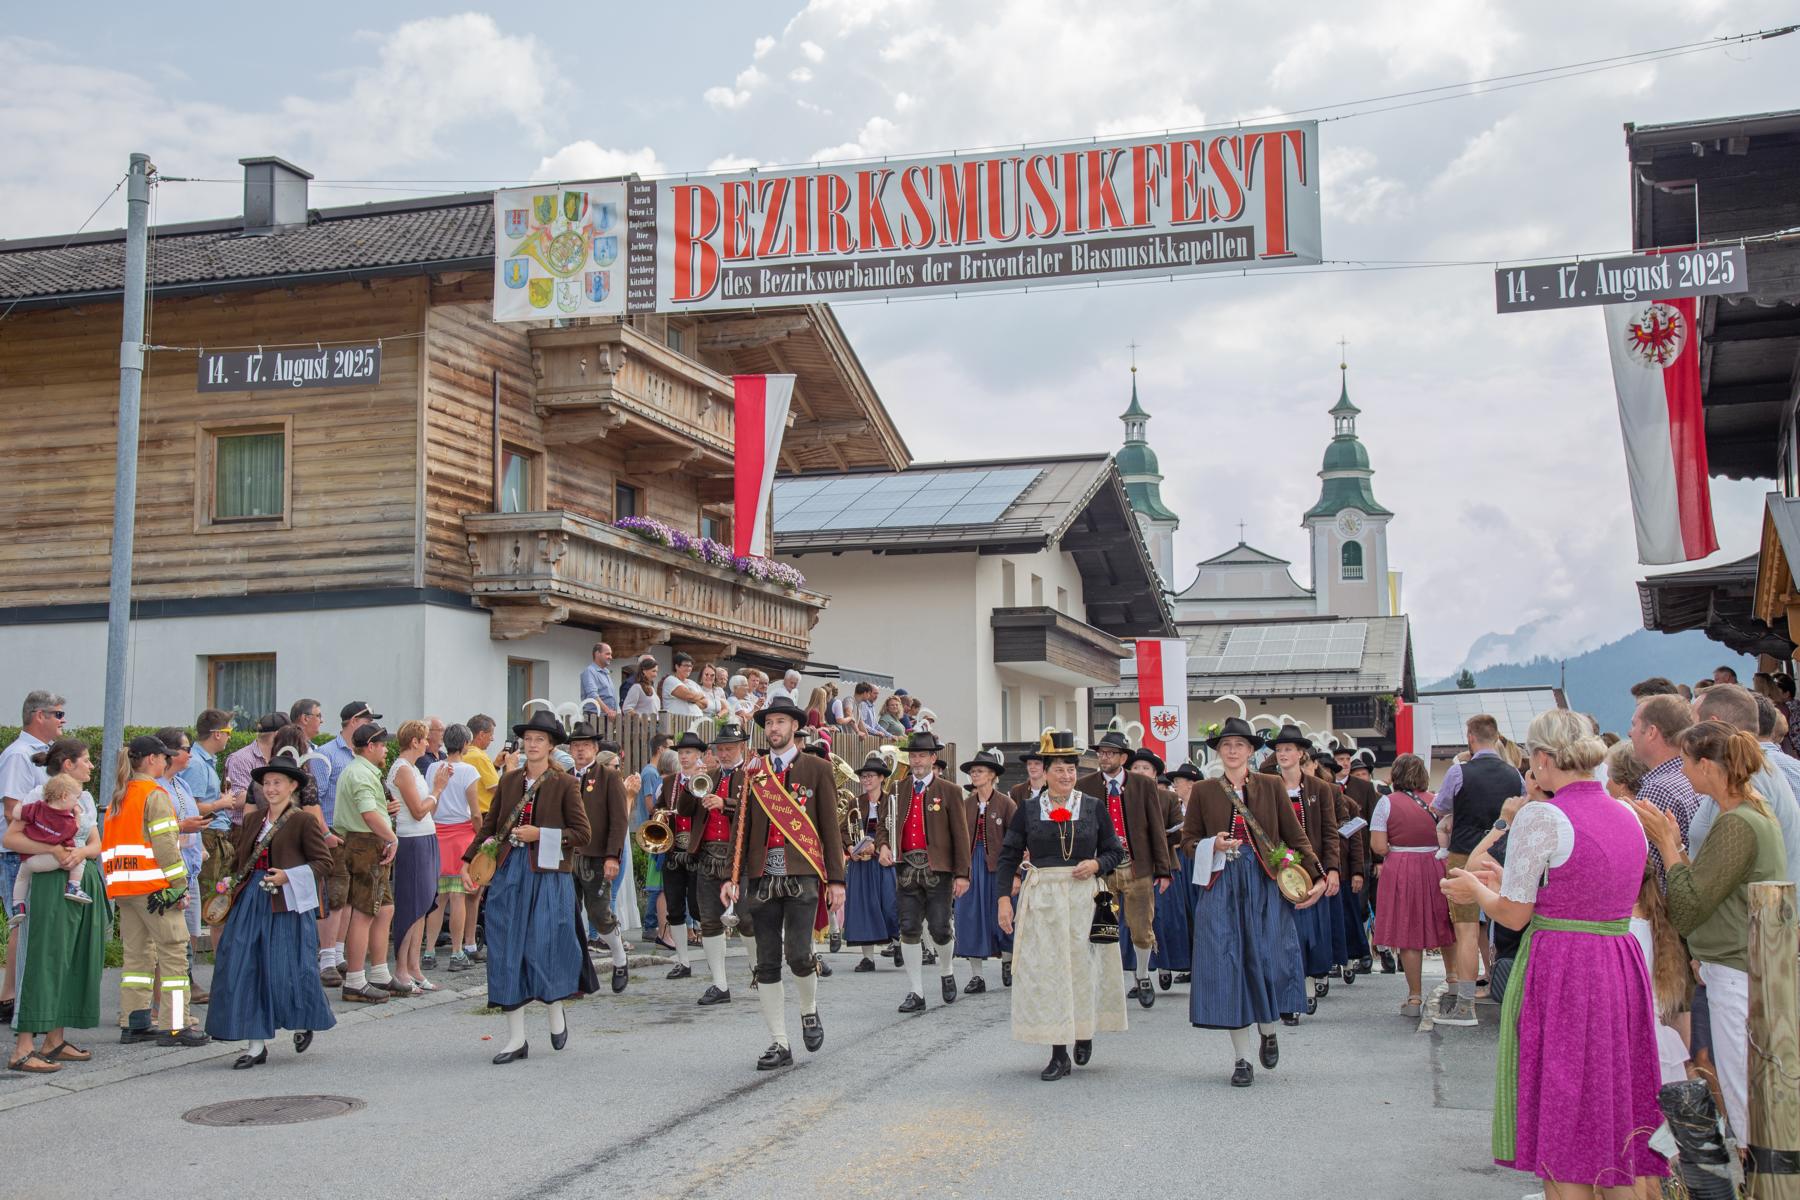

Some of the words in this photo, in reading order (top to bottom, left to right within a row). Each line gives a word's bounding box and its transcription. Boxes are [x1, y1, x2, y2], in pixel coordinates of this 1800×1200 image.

[669, 129, 1306, 304] BEZIRKSMUSIKFEST
[724, 271, 752, 297] des
[760, 259, 915, 295] Bezirksverbandes
[922, 256, 953, 283] der
[960, 247, 1063, 281] Brixentaler
[1071, 231, 1248, 272] Blasmusikkapellen
[1506, 270, 1536, 304] 14.
[1557, 265, 1587, 299] 17.
[1595, 255, 1673, 301] August
[1678, 250, 1735, 288] 2025
[207, 355, 229, 384] 14.
[246, 354, 267, 382] 17.
[272, 351, 329, 387] August
[333, 348, 375, 378] 2025
